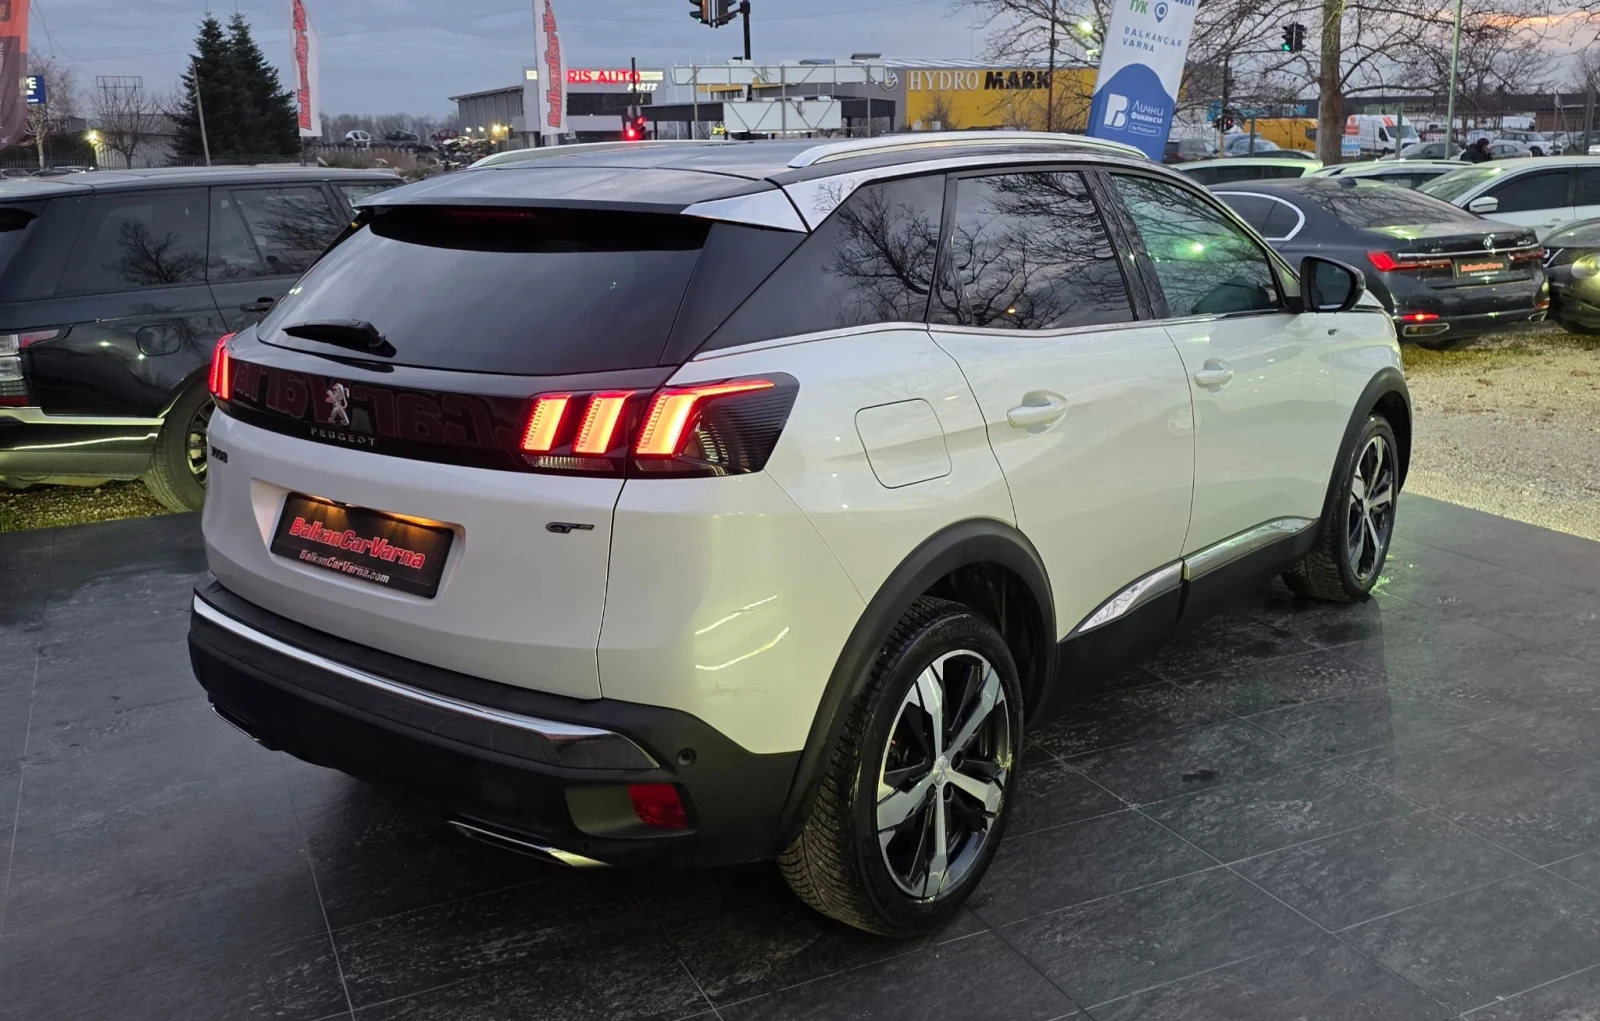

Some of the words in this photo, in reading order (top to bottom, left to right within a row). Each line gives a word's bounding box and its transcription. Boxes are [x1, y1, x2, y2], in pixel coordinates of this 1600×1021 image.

[1122, 38, 1155, 53] VARNA
[1124, 26, 1183, 48] BALKANCAR
[596, 70, 641, 83] AUTO
[908, 71, 979, 91] HYDRO
[984, 71, 1050, 90] MARK
[1132, 100, 1164, 116] Лични
[310, 427, 376, 447] PEUGEOT
[289, 517, 425, 569] BalkanCarVarna
[300, 549, 390, 583] BalkanCarVarna.com
